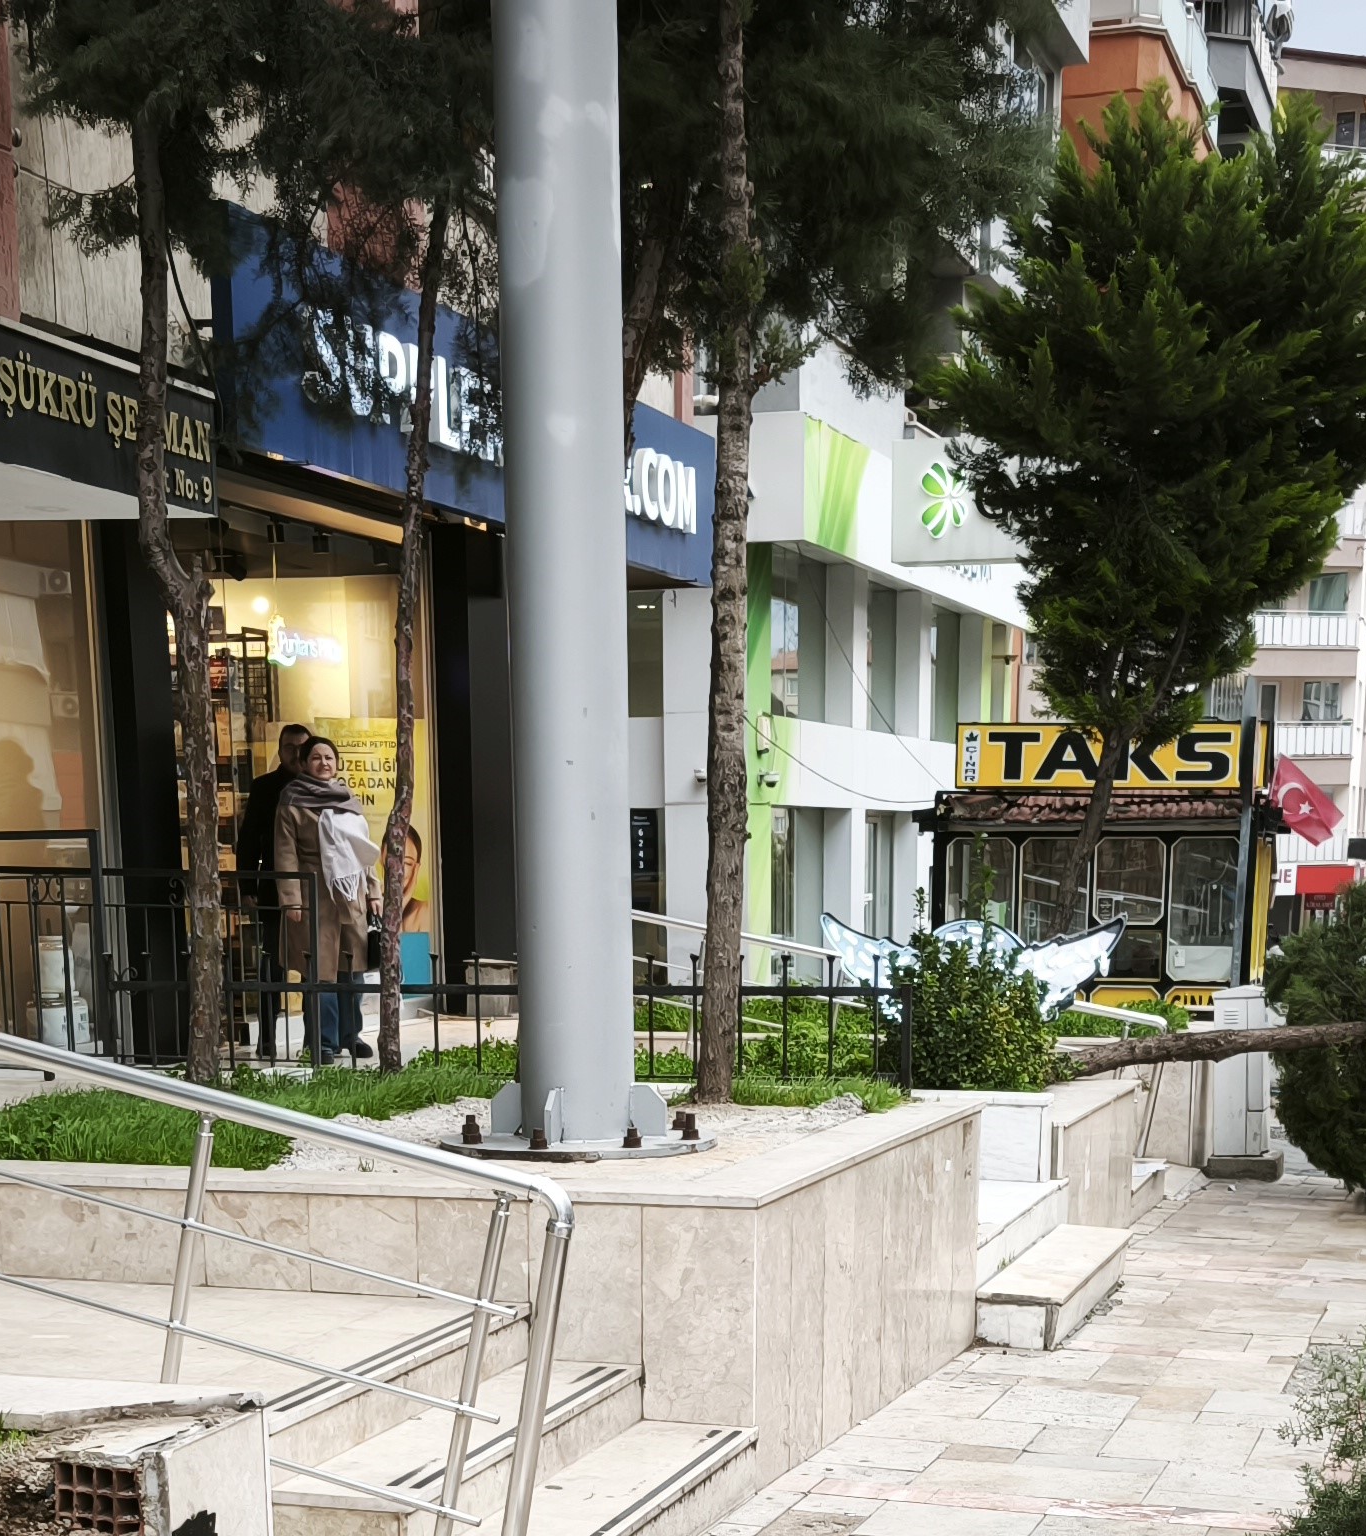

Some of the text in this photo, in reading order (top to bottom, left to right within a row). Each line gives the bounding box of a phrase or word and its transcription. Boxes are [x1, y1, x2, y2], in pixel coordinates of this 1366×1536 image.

[106, 391, 211, 464] ŞEMAN
[202, 475, 213, 504] 9
[987, 731, 1243, 782] TAKS
[337, 774, 397, 790] OĞADAN
